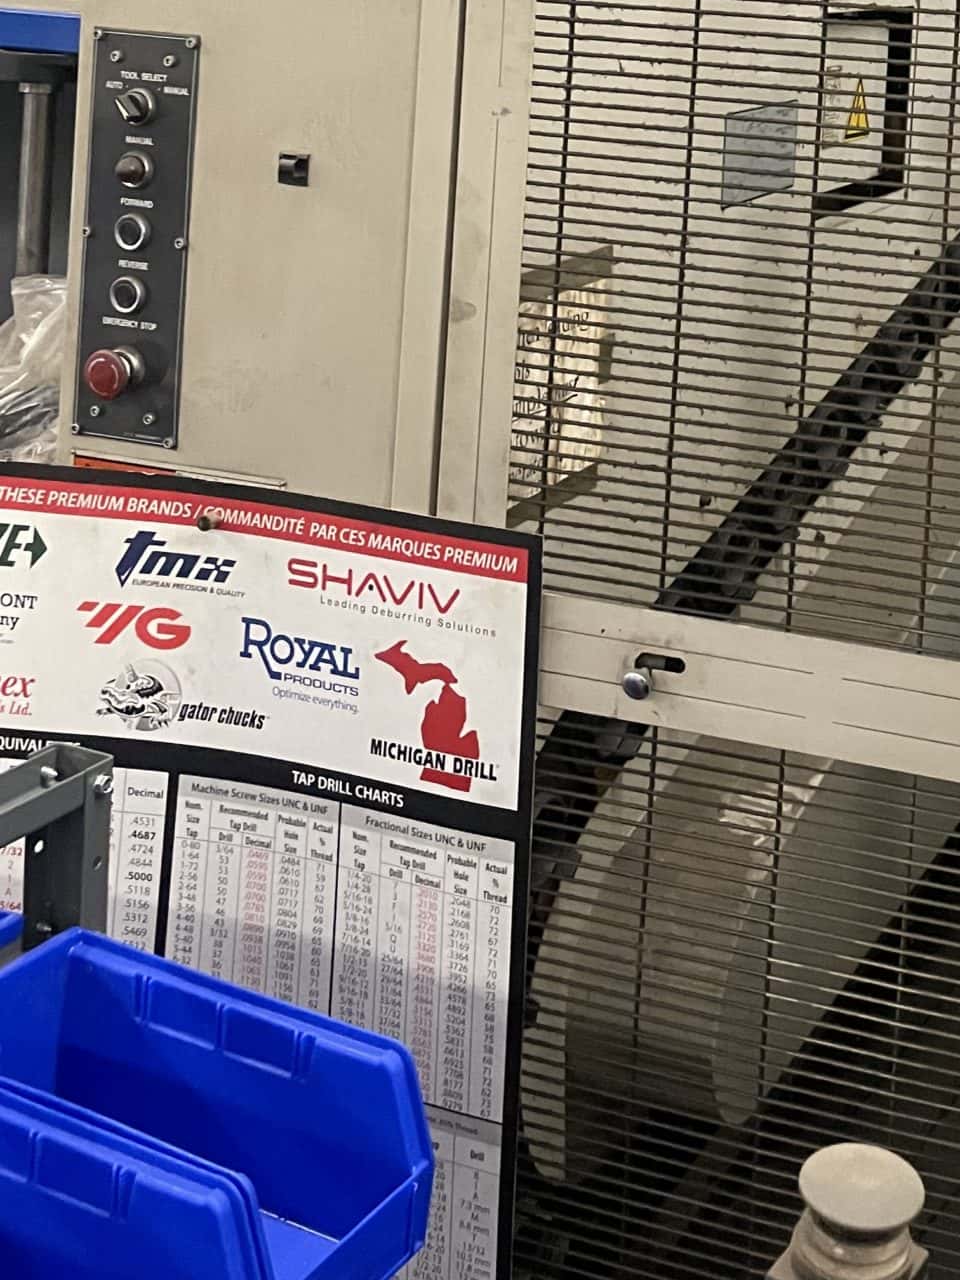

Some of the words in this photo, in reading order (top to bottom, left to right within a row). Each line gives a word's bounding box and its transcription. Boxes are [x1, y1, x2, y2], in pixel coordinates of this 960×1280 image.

[120, 71, 140, 80] TOOL
[141, 72, 168, 82] SELECT
[102, 316, 138, 328] EMERGENCY
[140, 321, 158, 331] STOP
[0, 486, 46, 505] THESE
[47, 491, 124, 512] PREMIUM
[127, 498, 193, 518] BRANDS
[309, 522, 337, 541] PAR
[339, 528, 366, 546] CES
[367, 533, 442, 560] MARQUES
[443, 547, 519, 573] PREMIUM
[216, 588, 246, 598] QUALITY
[288, 558, 460, 613] SHAVIV
[320, 592, 366, 614] Leading
[372, 605, 432, 627] Deburring
[438, 619, 497, 637] Solutions
[240, 617, 360, 680] ROYAL
[0, 675, 36, 698] ex
[284, 672, 359, 697] PRODUCTS
[272, 686, 311, 702] Optimize
[9, 701, 32, 716] Ltd.
[177, 702, 217, 721] gator
[217, 708, 266, 730] chucks
[370, 738, 446, 771] MICHIGAN
[453, 757, 498, 781] DRILL
[127, 786, 164, 800] Decimal
[291, 770, 316, 787] TAP
[318, 776, 353, 796] DRILL
[355, 784, 405, 808] CHARTS
[191, 782, 229, 797] Machine
[231, 788, 257, 801] Screw
[259, 793, 280, 806] Sizes
[281, 796, 300, 810] UNC
[302, 802, 309, 811] &
[310, 802, 329, 815] UNF
[186, 814, 200, 824] Size
[219, 805, 269, 821] Recommended
[186, 827, 198, 839] Tap
[229, 820, 242, 832] Tap
[243, 822, 257, 832] Drill
[313, 822, 334, 834] Actual
[365, 816, 409, 834] Fractional
[411, 825, 433, 841] Sizes
[435, 833, 455, 846] UNC
[457, 838, 464, 848] &
[466, 840, 487, 852] UNF
[128, 830, 156, 840] .4687
[219, 832, 233, 842] Drill
[245, 837, 272, 849] Decimal
[284, 843, 297, 854] Size
[310, 849, 333, 862] Thread
[353, 845, 367, 856] Size
[389, 840, 437, 860] Recommended
[354, 859, 366, 871] Tap
[399, 857, 411, 869] Tap
[412, 858, 426, 870] Drill
[447, 854, 477, 869] Probable
[485, 862, 508, 874] Actual
[124, 871, 153, 882] .5000
[389, 868, 403, 879] Drill
[415, 874, 441, 889] Decimal
[454, 884, 468, 896] Size
[483, 890, 508, 903] Thread
[490, 904, 500, 915] 70
